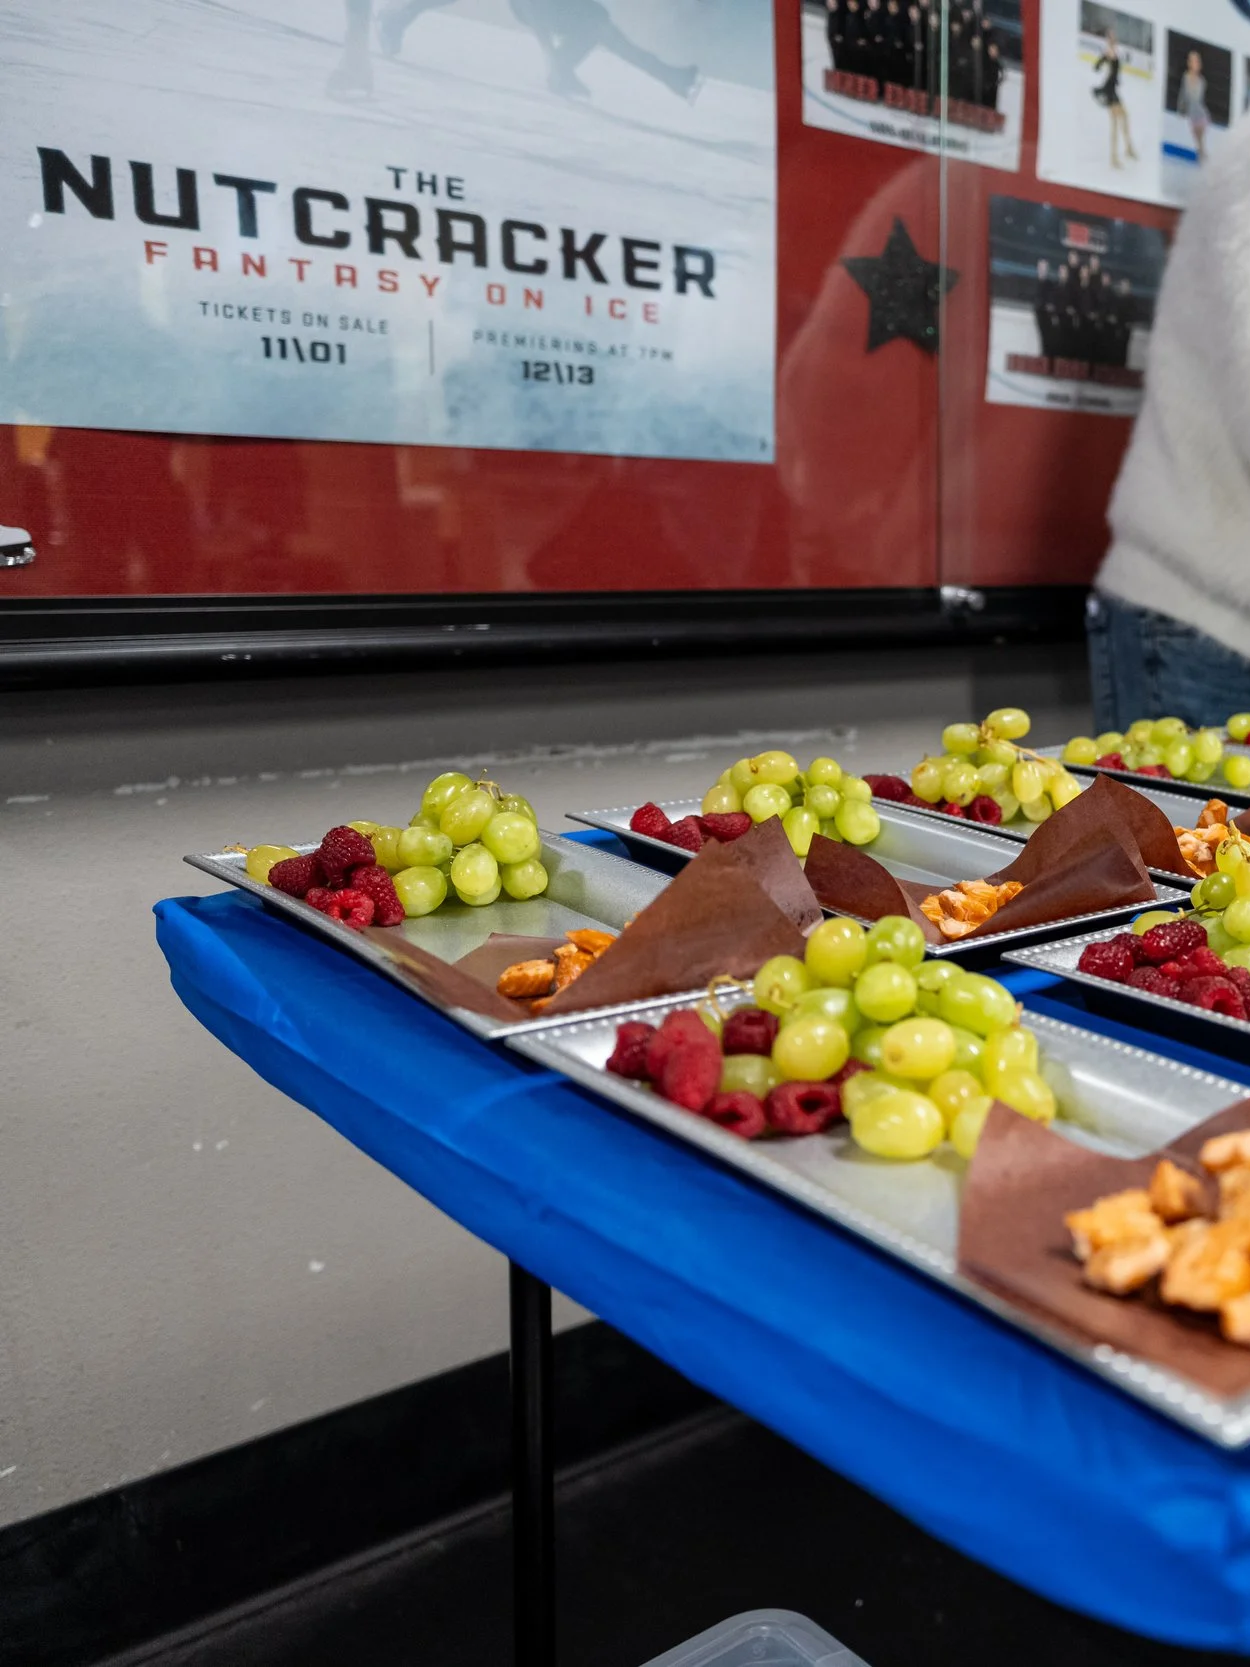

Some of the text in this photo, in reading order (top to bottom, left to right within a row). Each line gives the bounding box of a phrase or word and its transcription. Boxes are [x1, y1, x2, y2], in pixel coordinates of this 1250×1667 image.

[386, 165, 465, 200] THE
[36, 145, 716, 299] NUTCRACKER
[144, 239, 660, 325] FANTASY ON ICE
[198, 300, 389, 335] TICKETS ON SALE
[261, 335, 347, 365] 11\01
[472, 328, 598, 356] PREMIERING
[607, 347, 628, 358] AT
[521, 359, 595, 386] 12\13
